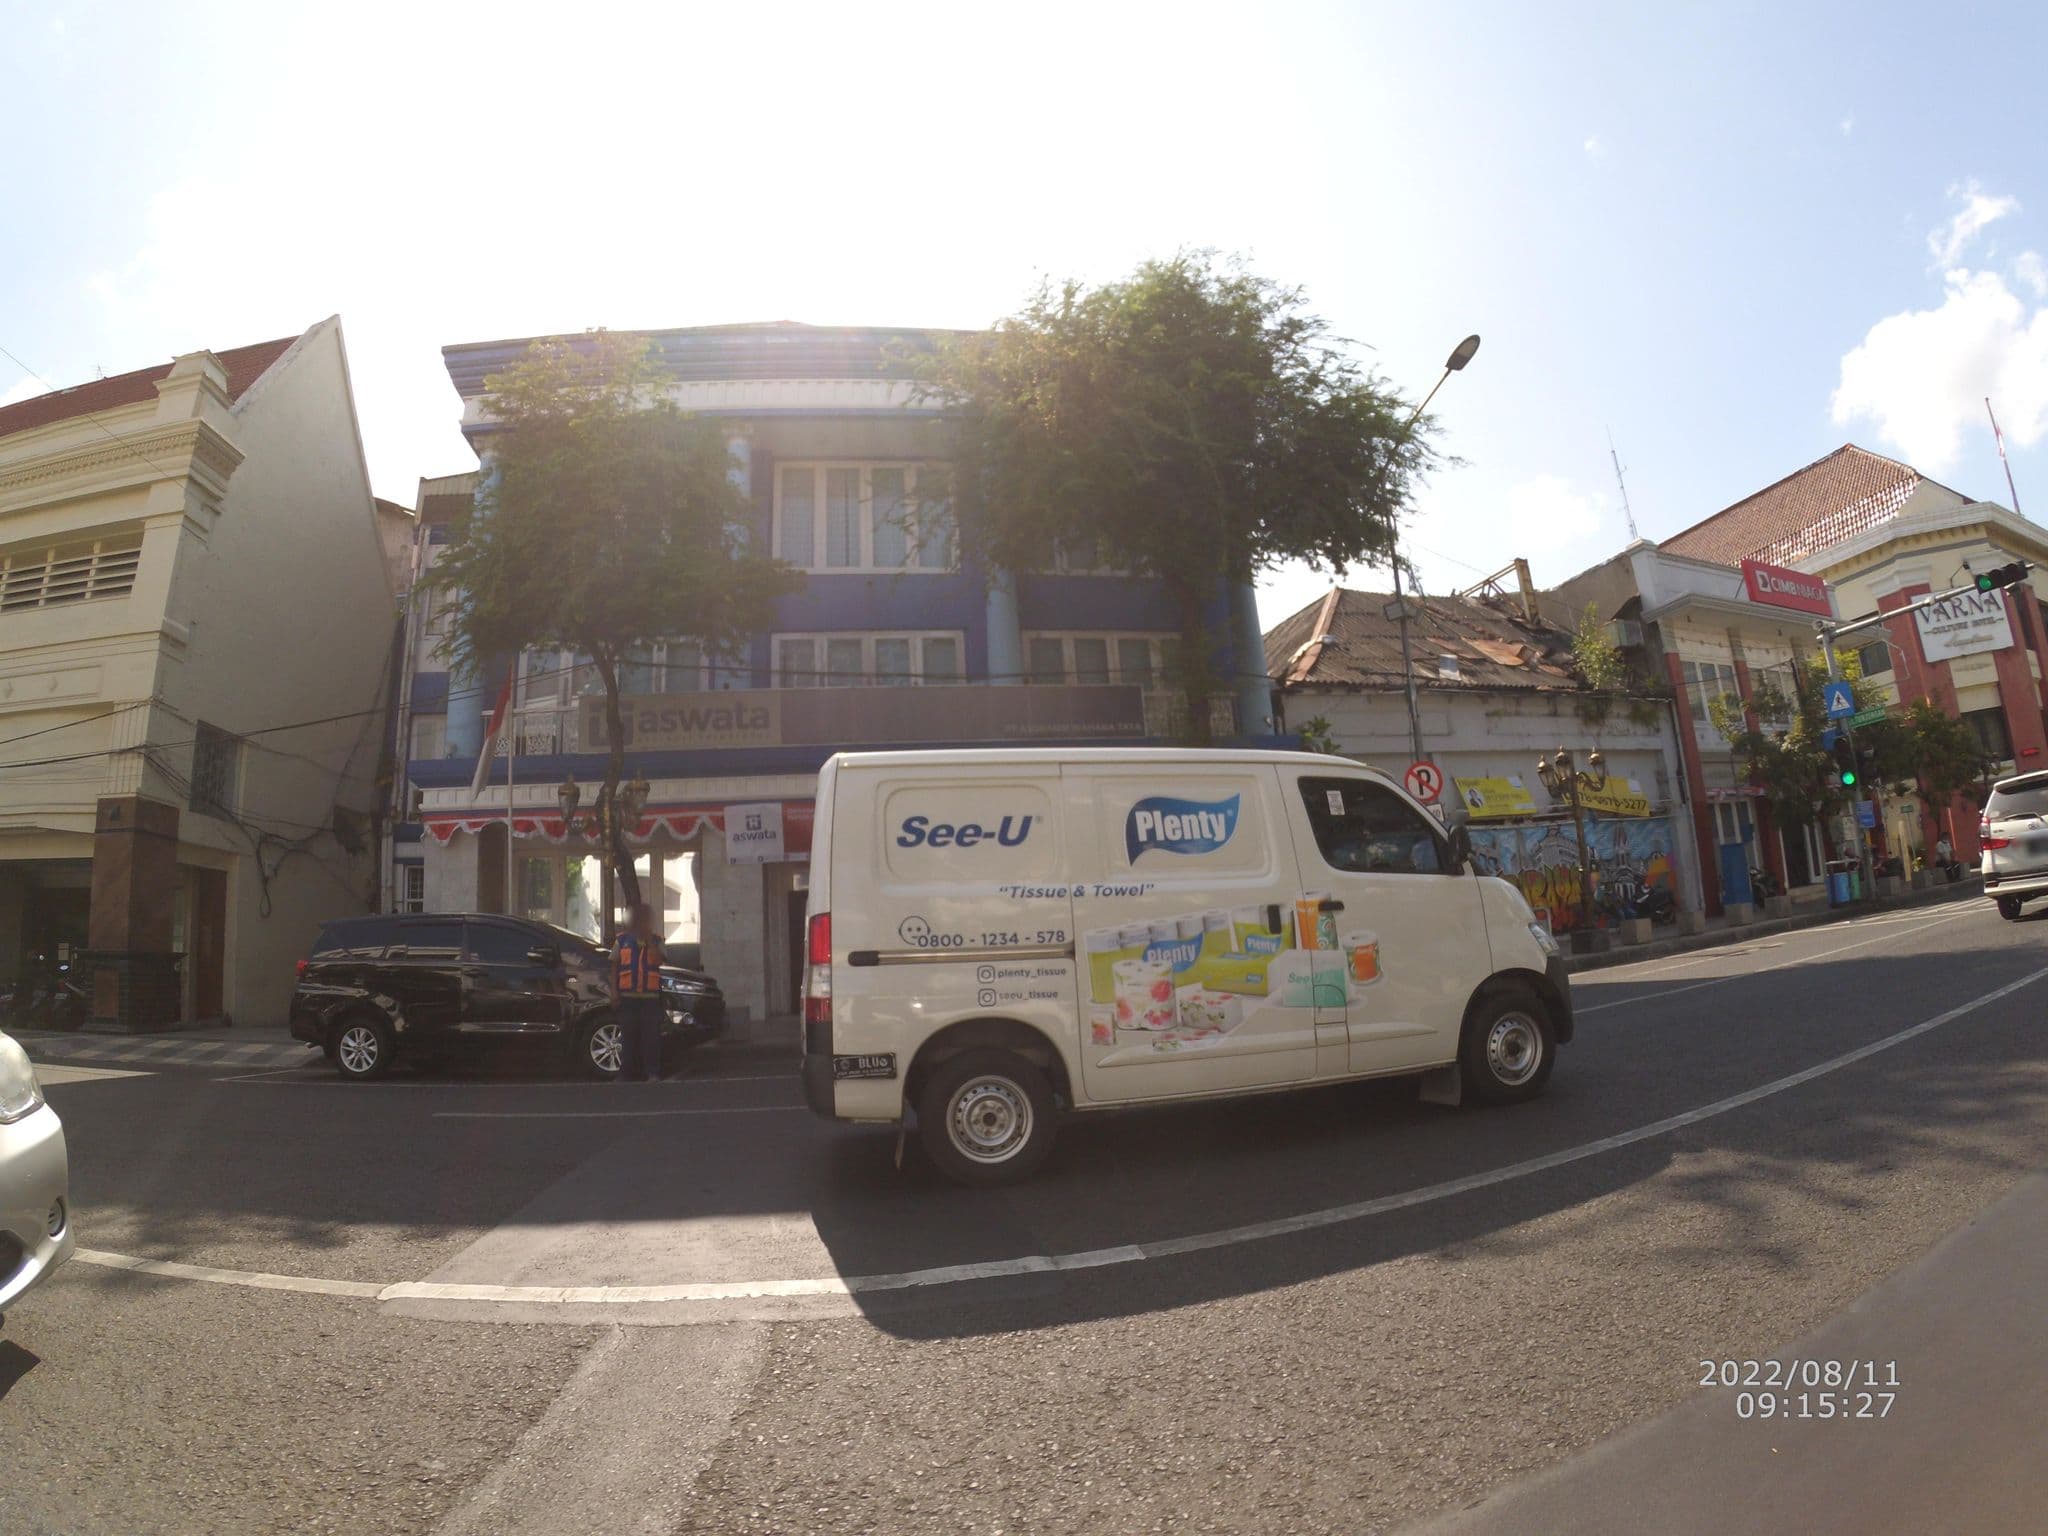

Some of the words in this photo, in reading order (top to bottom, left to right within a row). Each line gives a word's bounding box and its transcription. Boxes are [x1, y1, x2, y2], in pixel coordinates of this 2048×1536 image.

[1919, 591, 2002, 624] VARNA
[638, 701, 770, 733] aswata
[732, 829, 777, 842] aswata
[896, 816, 1033, 847] See-U
[1136, 810, 1227, 843] Plenty
[1073, 886, 1085, 898] &
[918, 933, 964, 948] 0800
[982, 932, 1019, 946] 1234
[1037, 930, 1066, 944] 578
[1147, 943, 1196, 966] Plenty
[997, 967, 1067, 979] plenty_tissue
